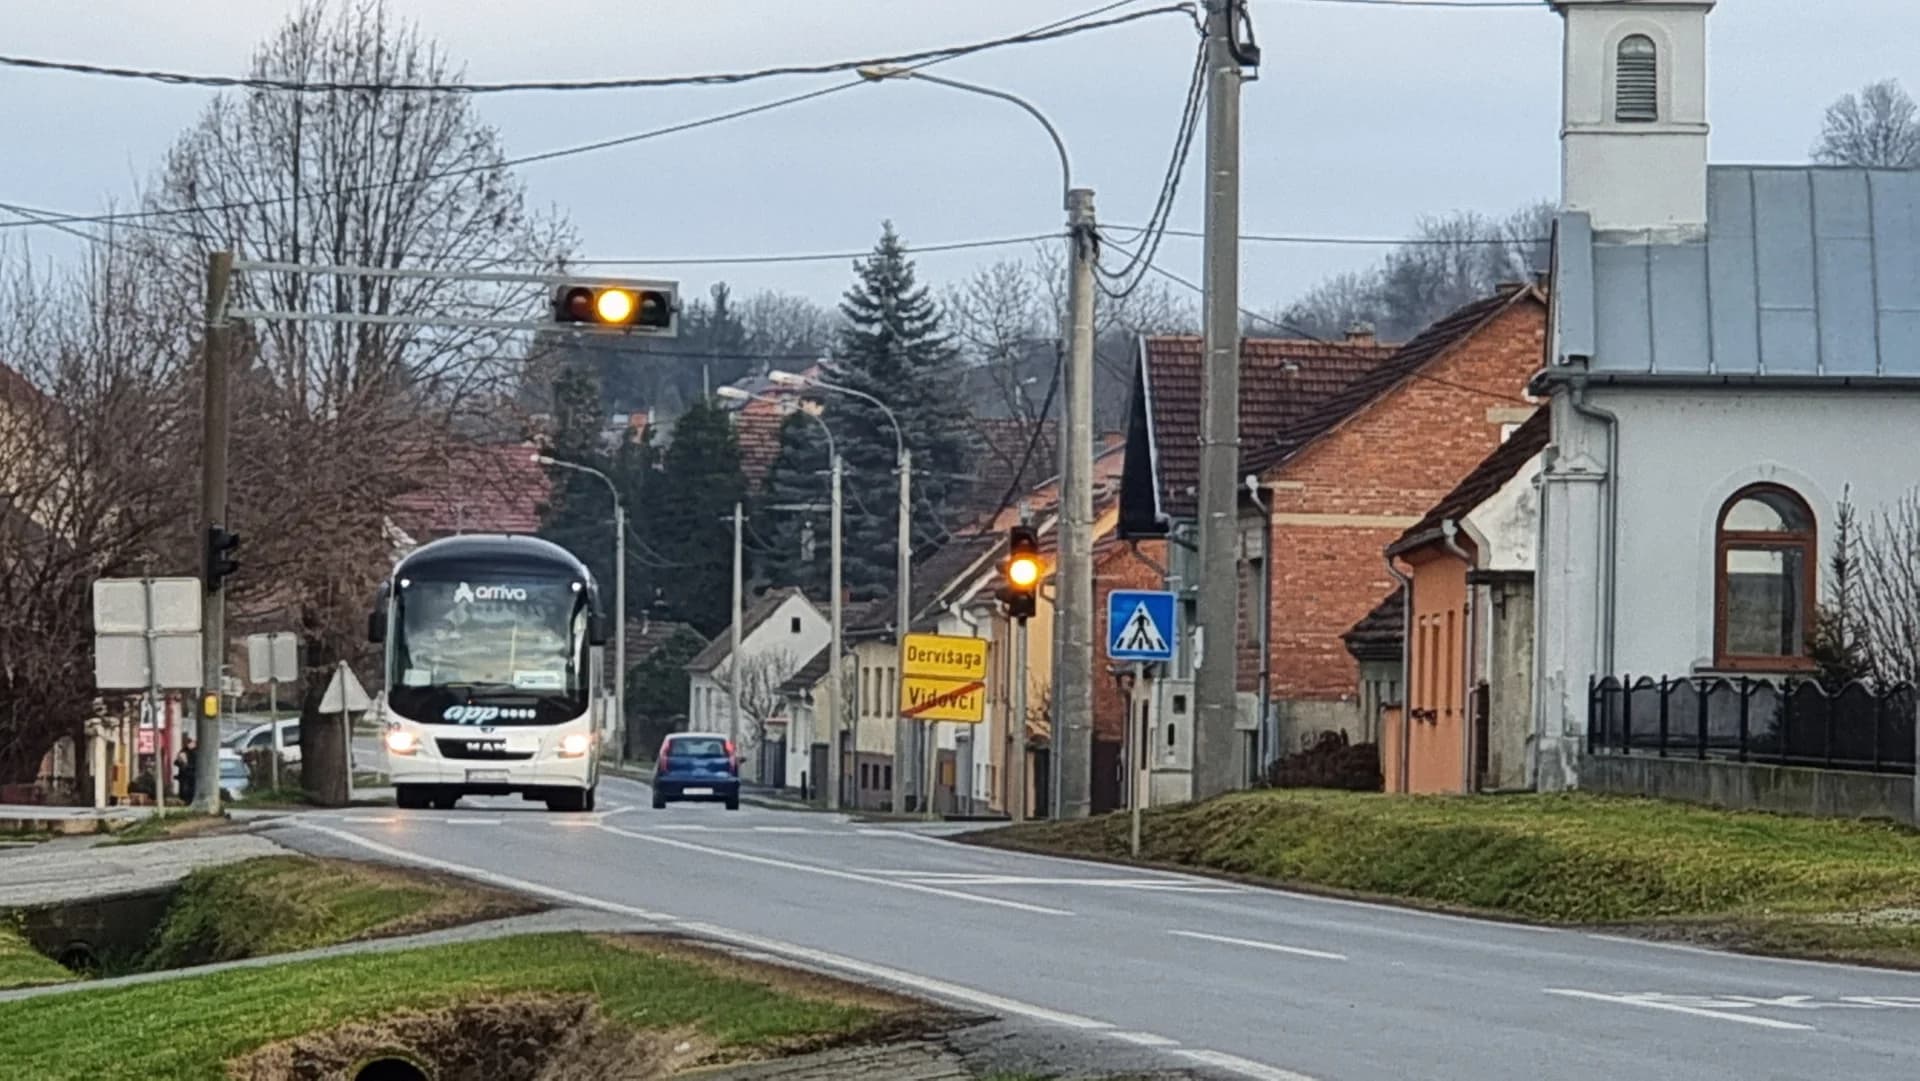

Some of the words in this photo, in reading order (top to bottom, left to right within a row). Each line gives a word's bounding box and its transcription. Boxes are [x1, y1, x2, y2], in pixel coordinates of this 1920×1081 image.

[475, 584, 527, 601] arriva
[907, 645, 982, 670] Dervišaga
[908, 686, 975, 711] Vidovci
